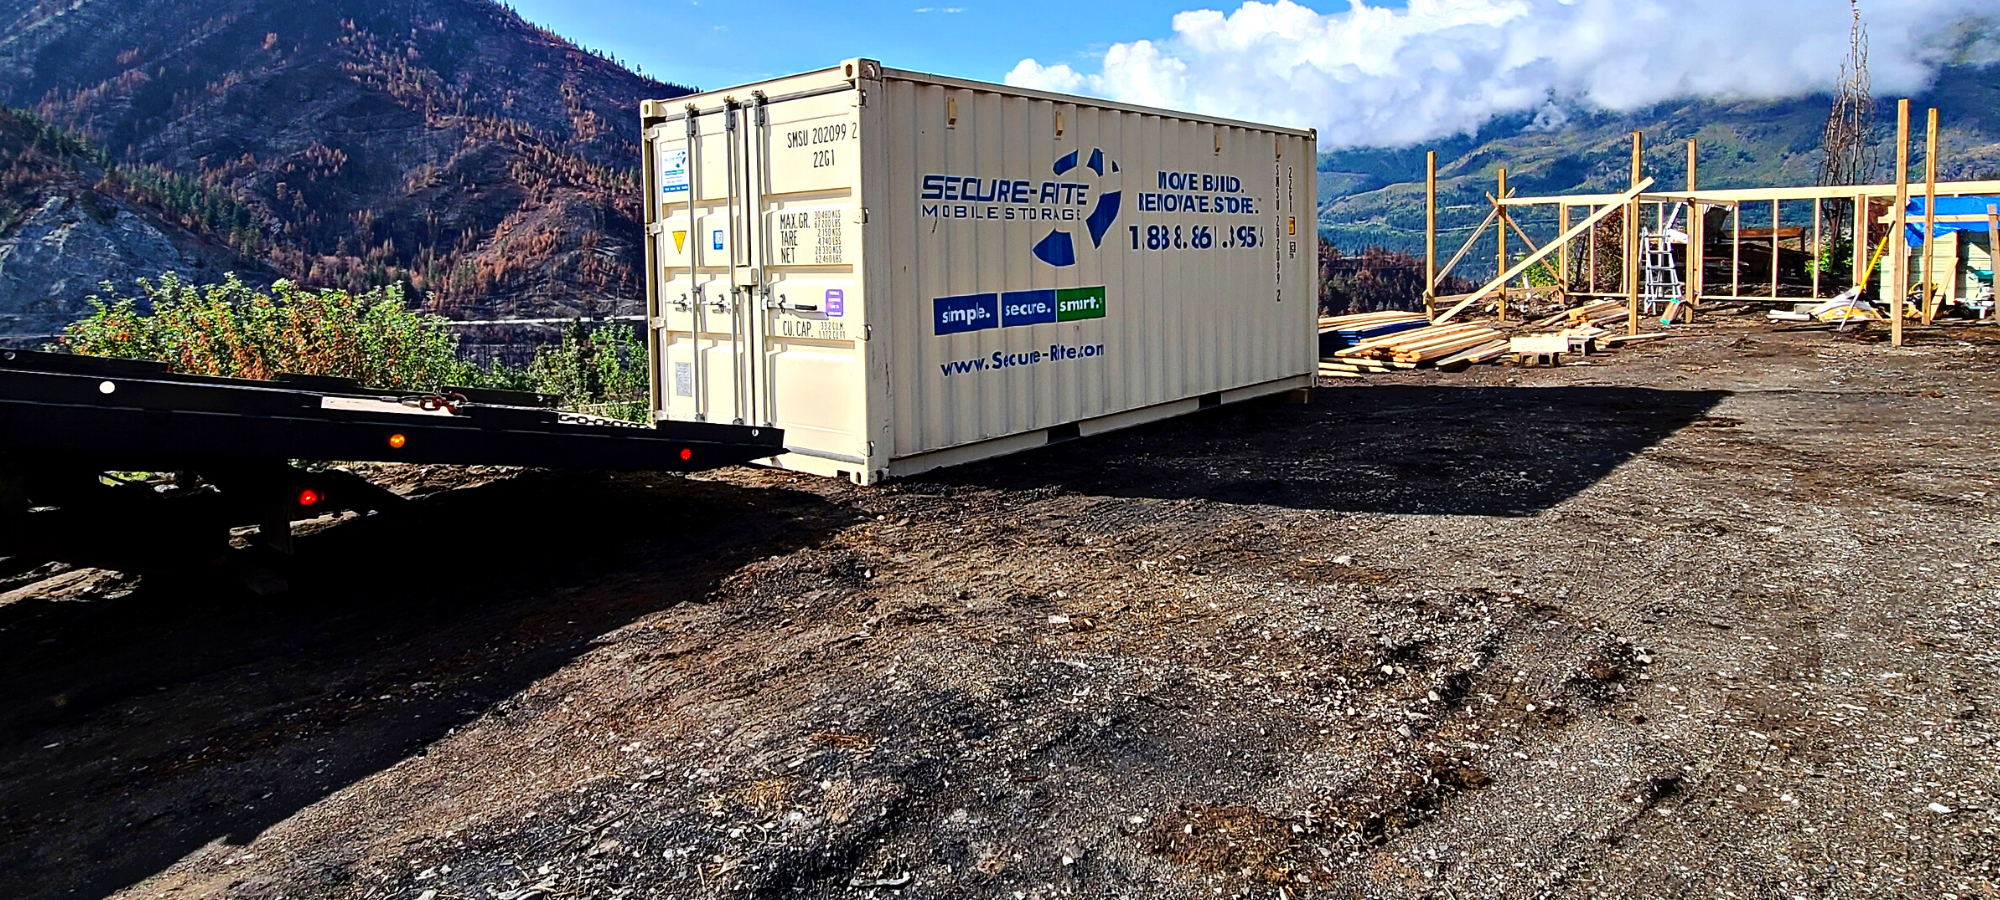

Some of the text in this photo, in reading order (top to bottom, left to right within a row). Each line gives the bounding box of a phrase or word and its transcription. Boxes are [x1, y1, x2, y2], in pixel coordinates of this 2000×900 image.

[787, 121, 858, 149] SMSU 202099 2
[813, 148, 835, 169] 22G1
[921, 175, 1090, 206] SECURE-RITE
[922, 204, 1081, 221] MOBILE STORAGE
[780, 230, 798, 247] TARE
[781, 247, 795, 264] NET
[942, 302, 991, 326] simple.
[1004, 302, 1052, 317] secure.
